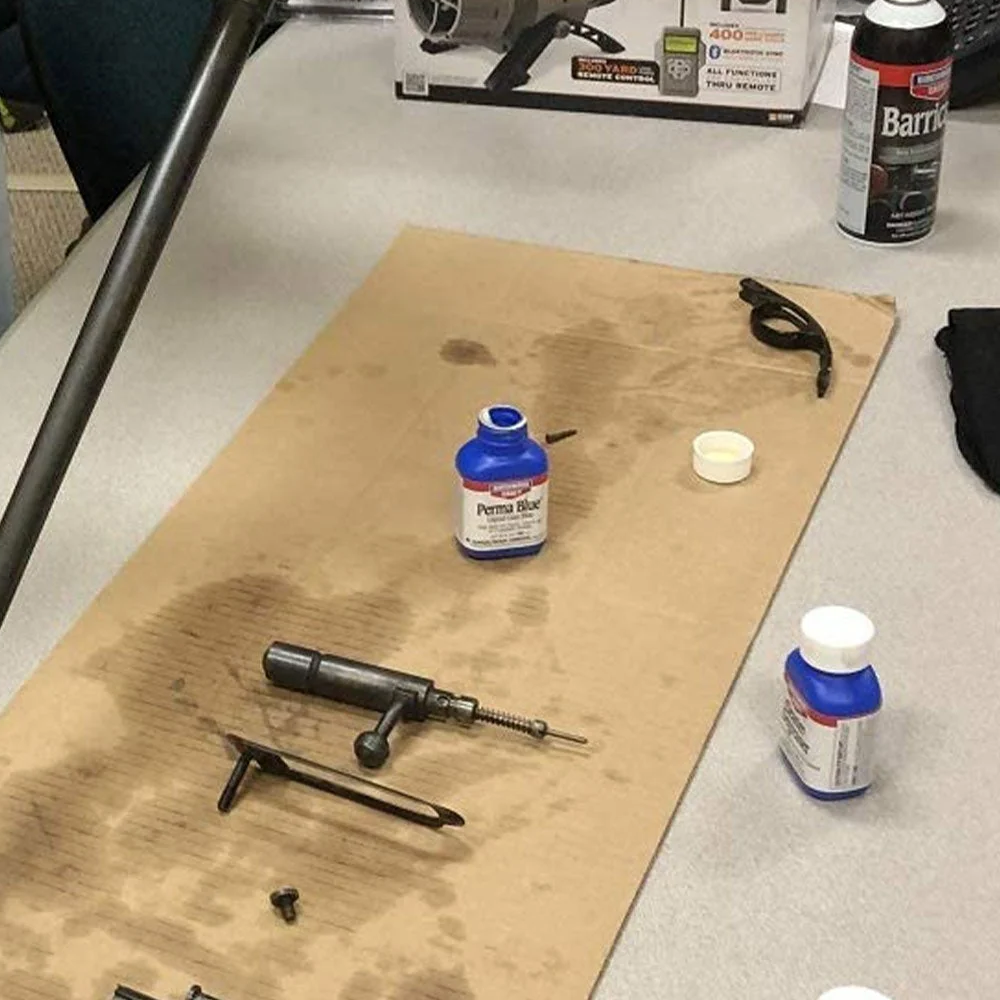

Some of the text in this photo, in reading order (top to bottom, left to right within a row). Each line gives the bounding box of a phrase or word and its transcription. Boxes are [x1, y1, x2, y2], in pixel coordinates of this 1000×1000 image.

[709, 29, 744, 42] 400
[604, 64, 637, 75] YARD
[707, 68, 777, 79] ALL FUNCTIONS
[577, 72, 613, 80] REMOTE
[706, 81, 777, 92] THRU REMOTE
[476, 499, 541, 517] Perma Blue
